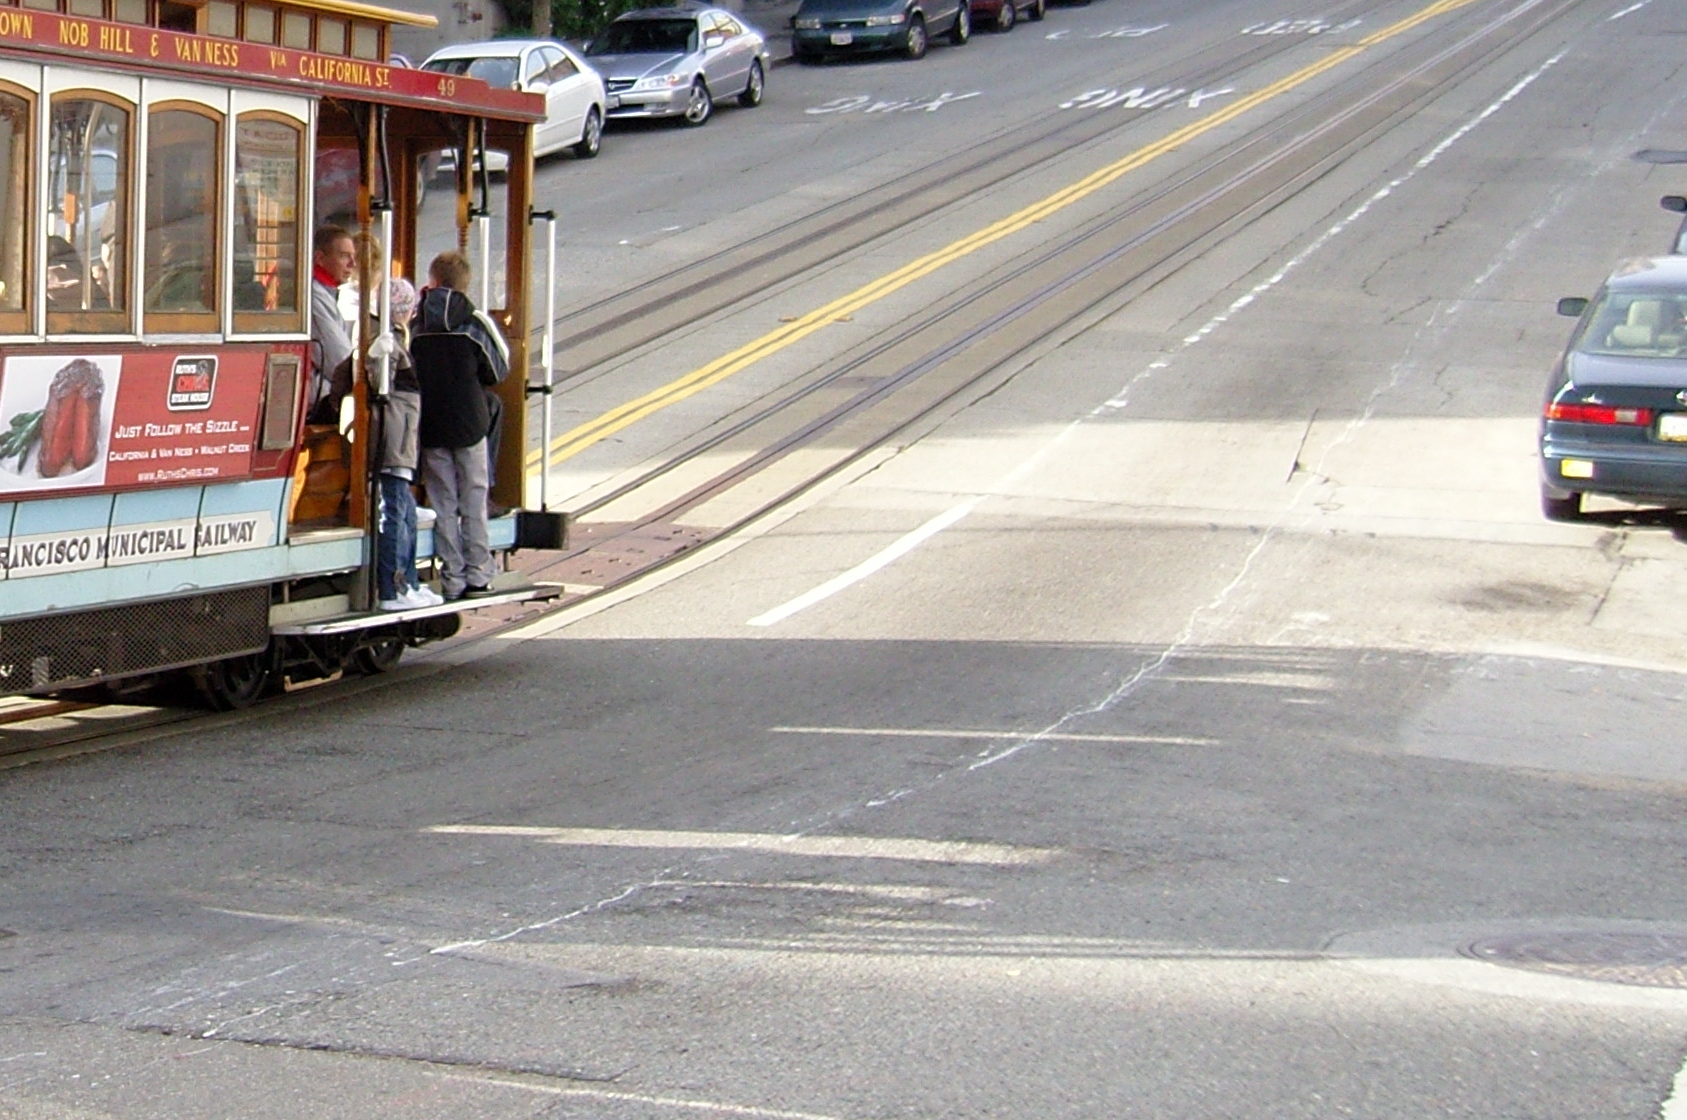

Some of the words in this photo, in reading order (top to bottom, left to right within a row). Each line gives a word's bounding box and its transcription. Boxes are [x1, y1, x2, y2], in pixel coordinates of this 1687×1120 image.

[60, 20, 89, 47] NOB
[100, 26, 133, 53] HILL
[150, 34, 159, 57] &
[175, 37, 201, 62] VAN
[205, 42, 239, 67] NESS
[299, 56, 372, 87] CALIFORNIA
[437, 78, 456, 97] 49
[96, 528, 187, 560] MUNICIPAL
